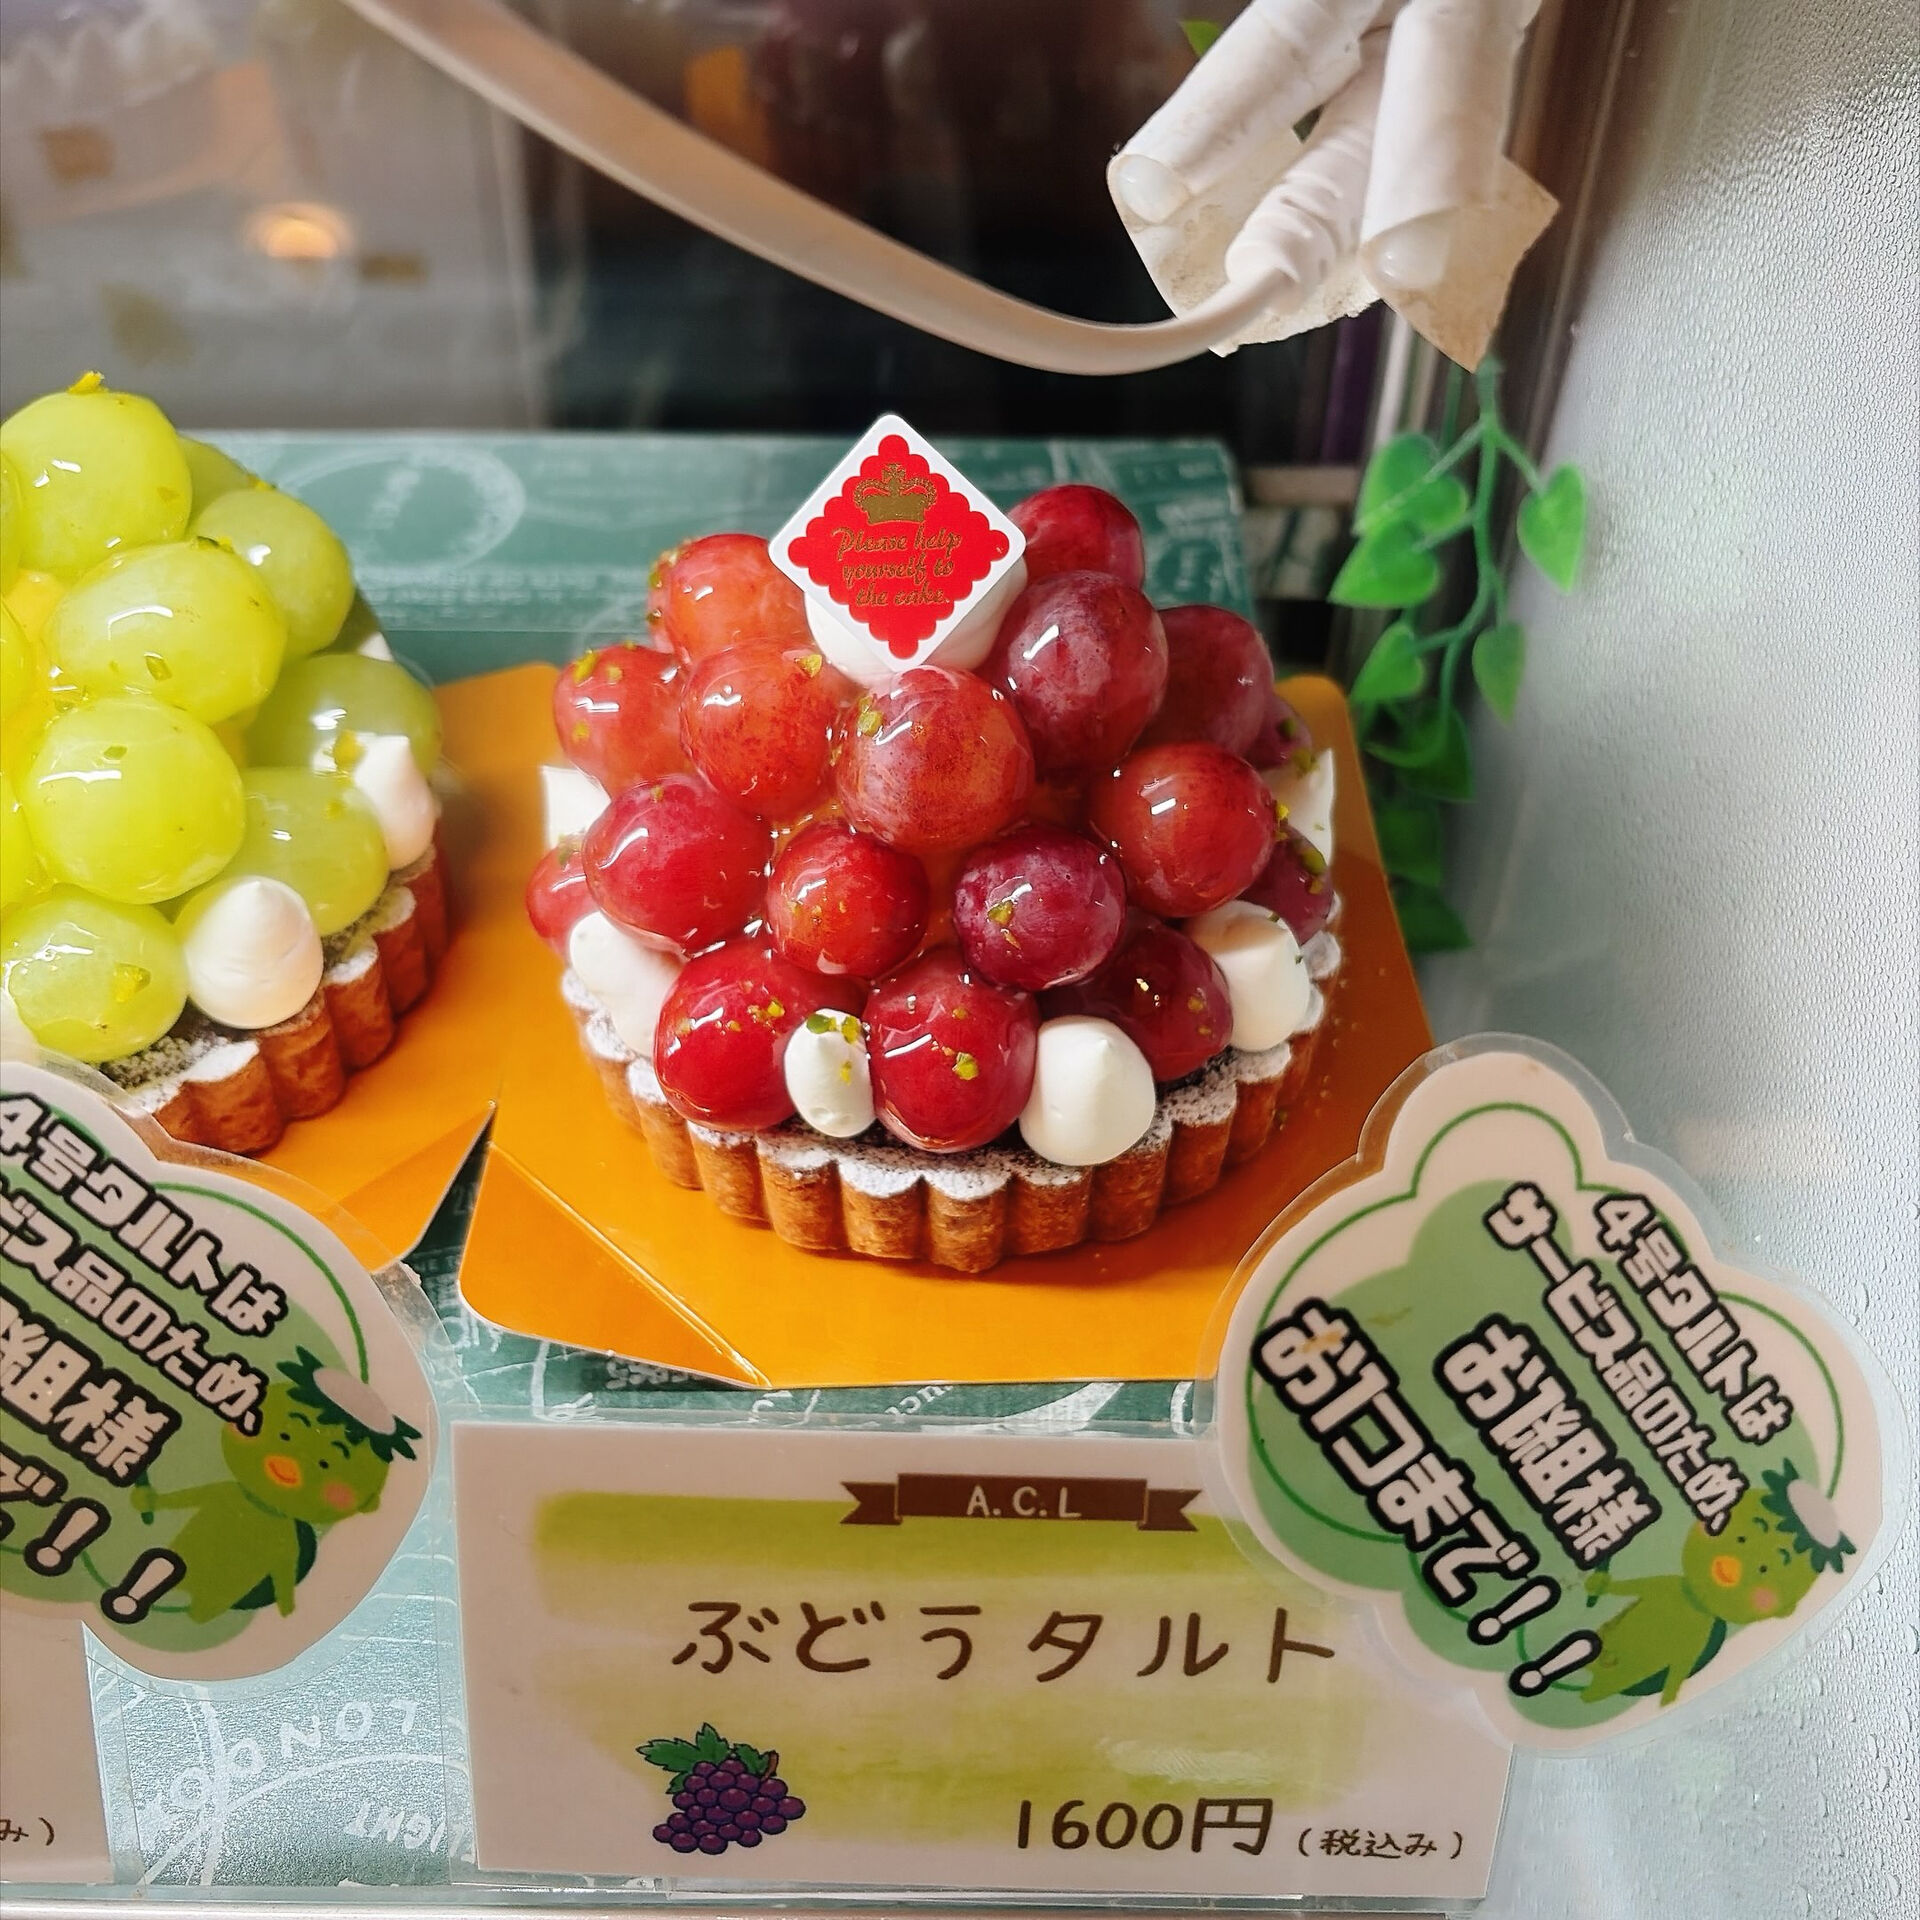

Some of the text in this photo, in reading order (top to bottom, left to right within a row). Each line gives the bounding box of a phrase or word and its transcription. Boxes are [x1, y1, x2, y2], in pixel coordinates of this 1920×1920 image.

[832, 525, 961, 561] Please help
[843, 556, 953, 588] yourself to
[856, 583, 888, 606] the
[1596, 1196, 1792, 1442] 4号タルトは
[1485, 1184, 1747, 1533] サービス品のため、
[1438, 1320, 1658, 1562] お1組様
[672, 1600, 1335, 1683] ぶどうタルト
[1017, 1798, 1273, 1856] 1600円
